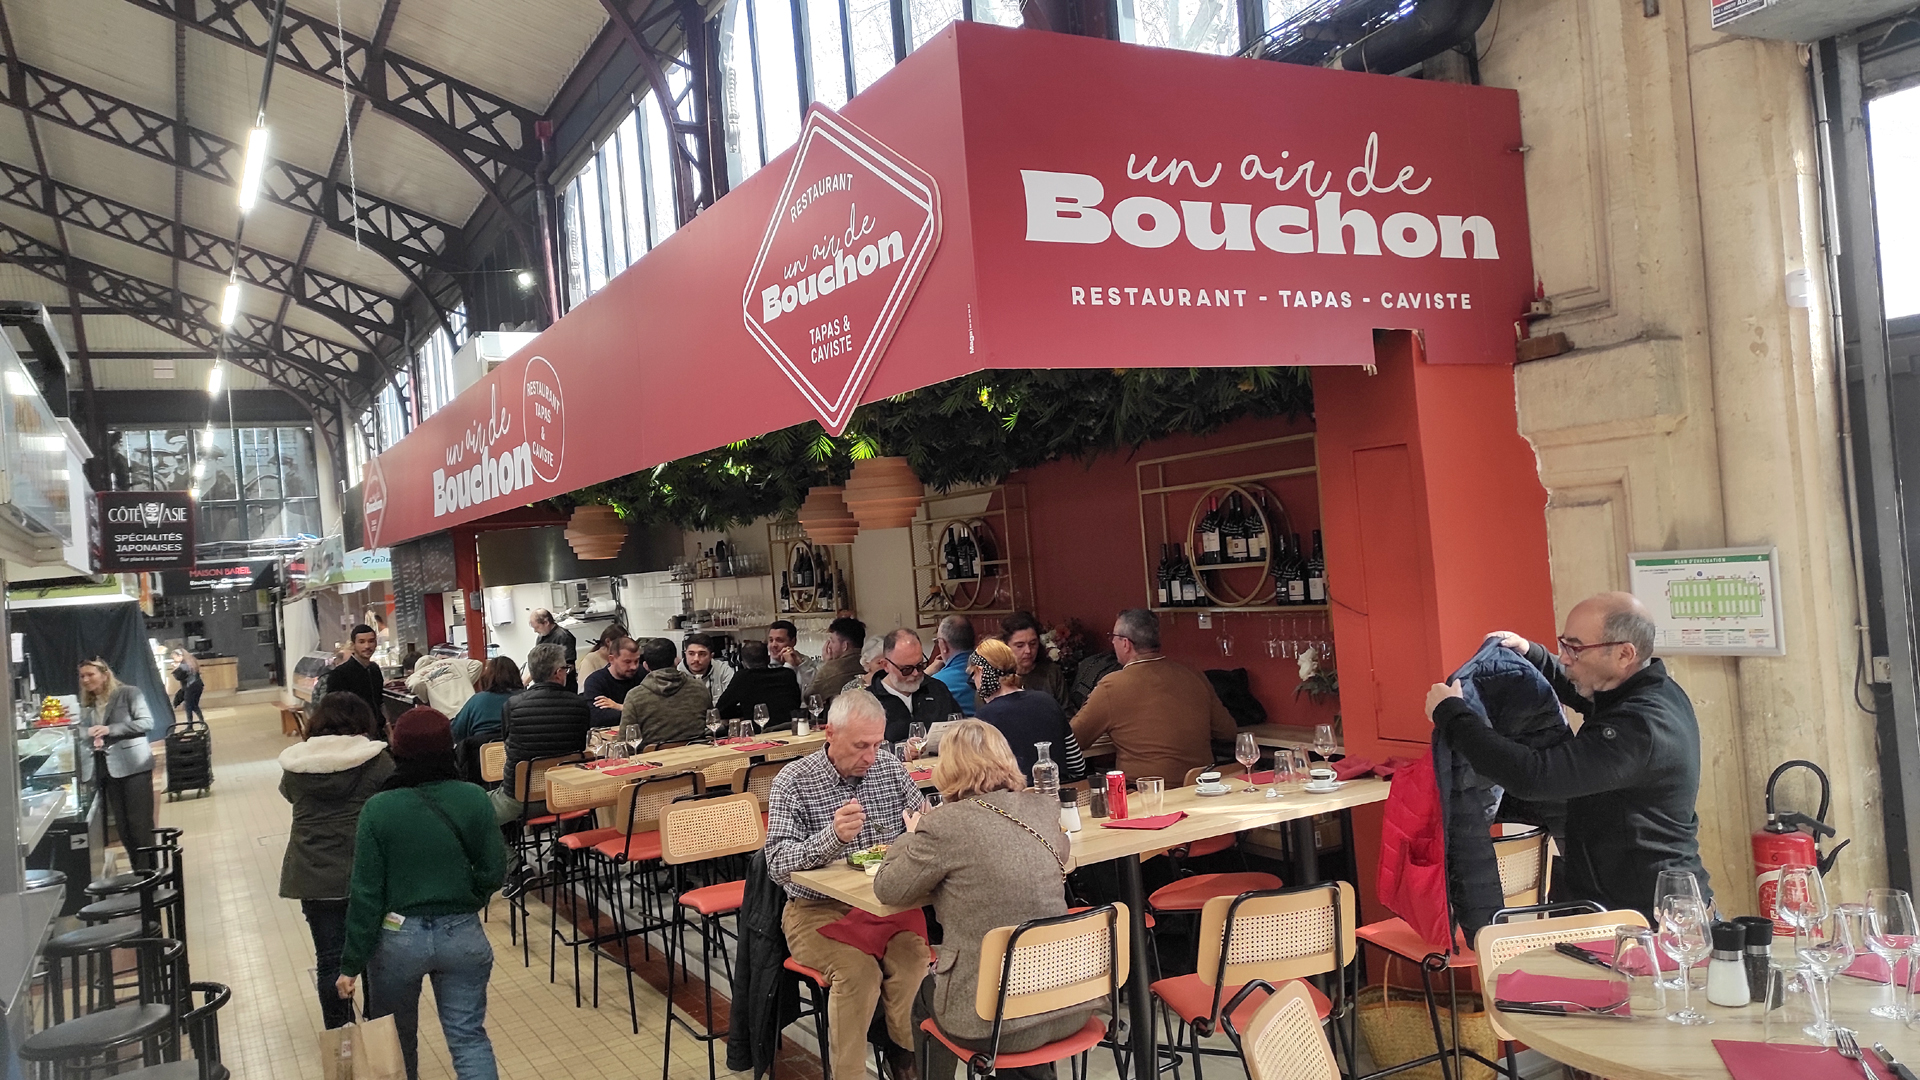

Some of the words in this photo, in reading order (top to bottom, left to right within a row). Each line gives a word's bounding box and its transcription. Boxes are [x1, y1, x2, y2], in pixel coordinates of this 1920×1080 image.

[1127, 153, 1223, 188] un
[1240, 151, 1332, 197] air
[1346, 131, 1432, 196] de
[790, 172, 853, 222] RESTAURANT
[1020, 169, 1500, 260] Bouchon
[783, 255, 809, 280] un
[812, 234, 841, 263] air
[844, 202, 876, 248] de
[761, 230, 905, 324] Bouchon
[1071, 286, 1247, 307] RESTAURANT
[1278, 290, 1353, 308] TAPAS
[1380, 292, 1472, 310] CAVISTE
[809, 318, 841, 345] TAPAS
[843, 315, 851, 332] &
[810, 333, 853, 365] CAVISTE
[526, 380, 561, 415] RESTAURANT
[534, 401, 552, 424] TAPAS
[446, 440, 464, 467] un
[465, 418, 487, 454] air
[488, 383, 511, 446] de
[540, 425, 546, 441] &
[532, 440, 554, 468] CAVISTE
[432, 440, 534, 517] Bouchon
[108, 505, 142, 523] CÔTÉ
[162, 507, 188, 522] ASIE
[114, 532, 183, 542] SPÉCIALITÉS
[115, 543, 182, 553] JAPONAISES
[189, 568, 223, 578] MAISON
